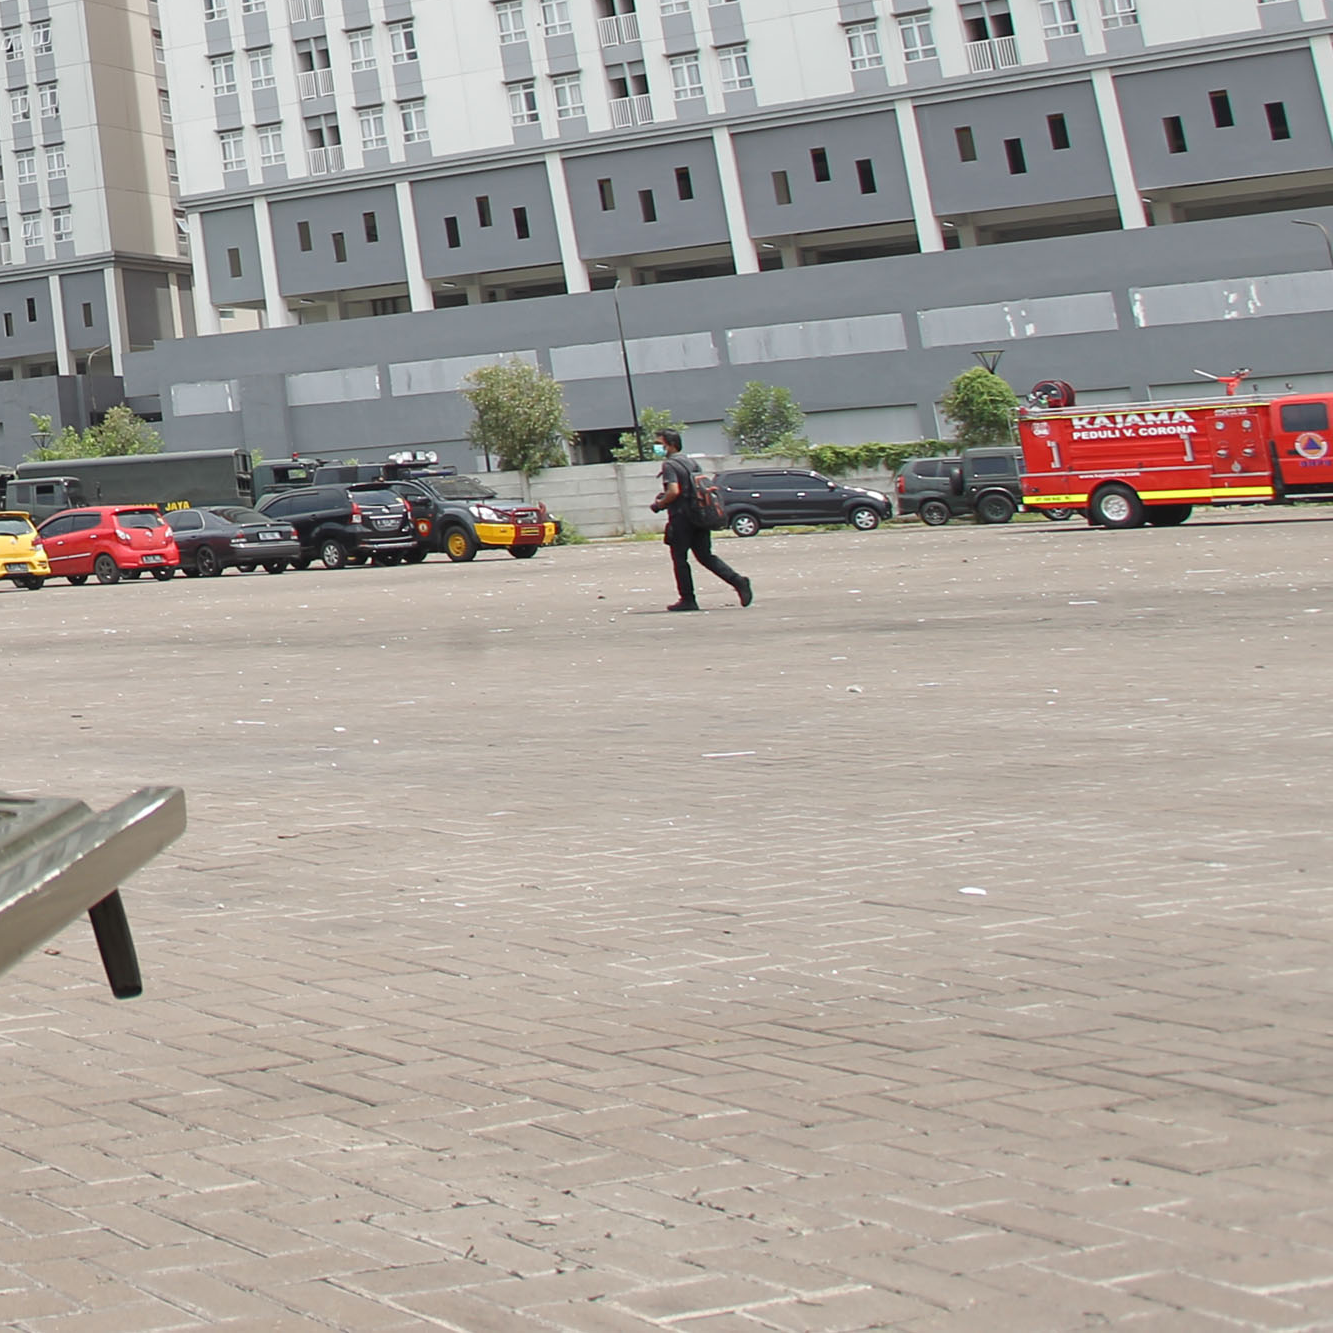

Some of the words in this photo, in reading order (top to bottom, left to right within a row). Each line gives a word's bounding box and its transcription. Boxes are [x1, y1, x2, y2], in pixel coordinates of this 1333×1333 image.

[1072, 410, 1195, 429] KAJAMA
[1073, 429, 1120, 440] PEDULI
[1123, 428, 1136, 437] V.
[1138, 425, 1197, 436] CORONA
[164, 500, 190, 511] JAYA
